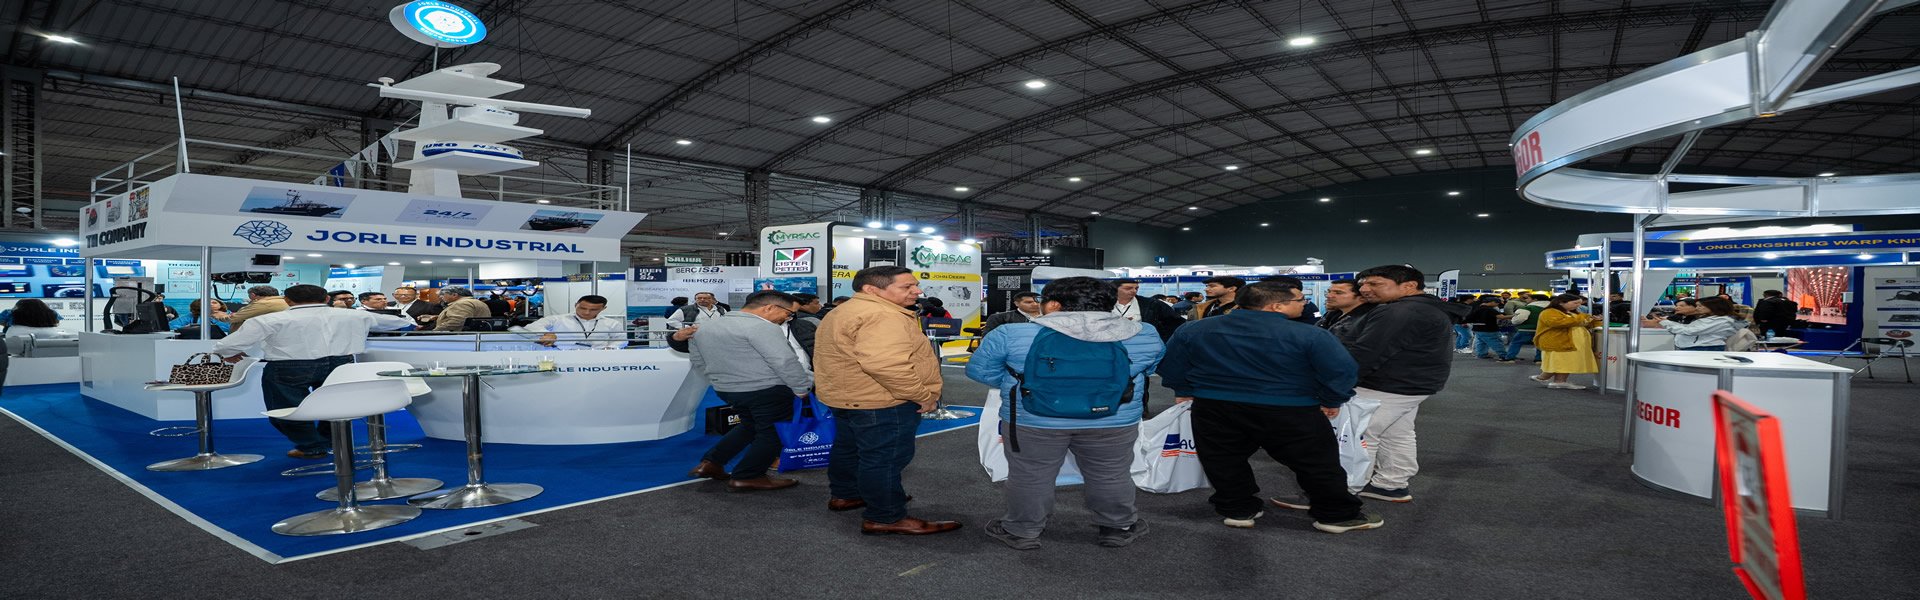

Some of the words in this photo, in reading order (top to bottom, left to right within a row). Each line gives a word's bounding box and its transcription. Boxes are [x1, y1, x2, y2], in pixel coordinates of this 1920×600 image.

[423, 209, 472, 217] 24/7
[99, 221, 147, 246] COMPANY
[775, 231, 821, 241] MYRSAC
[306, 229, 417, 246] JORLE
[426, 235, 585, 254] INDUSTRIAL
[1698, 240, 1829, 251] LONGLONGSHENG
[1833, 238, 1883, 246] WARP
[1887, 237, 1920, 245] KNI
[919, 251, 972, 264] MYRSAC
[1440, 279, 1448, 297] SUZUKI
[578, 364, 660, 372] INDUSTRIAL
